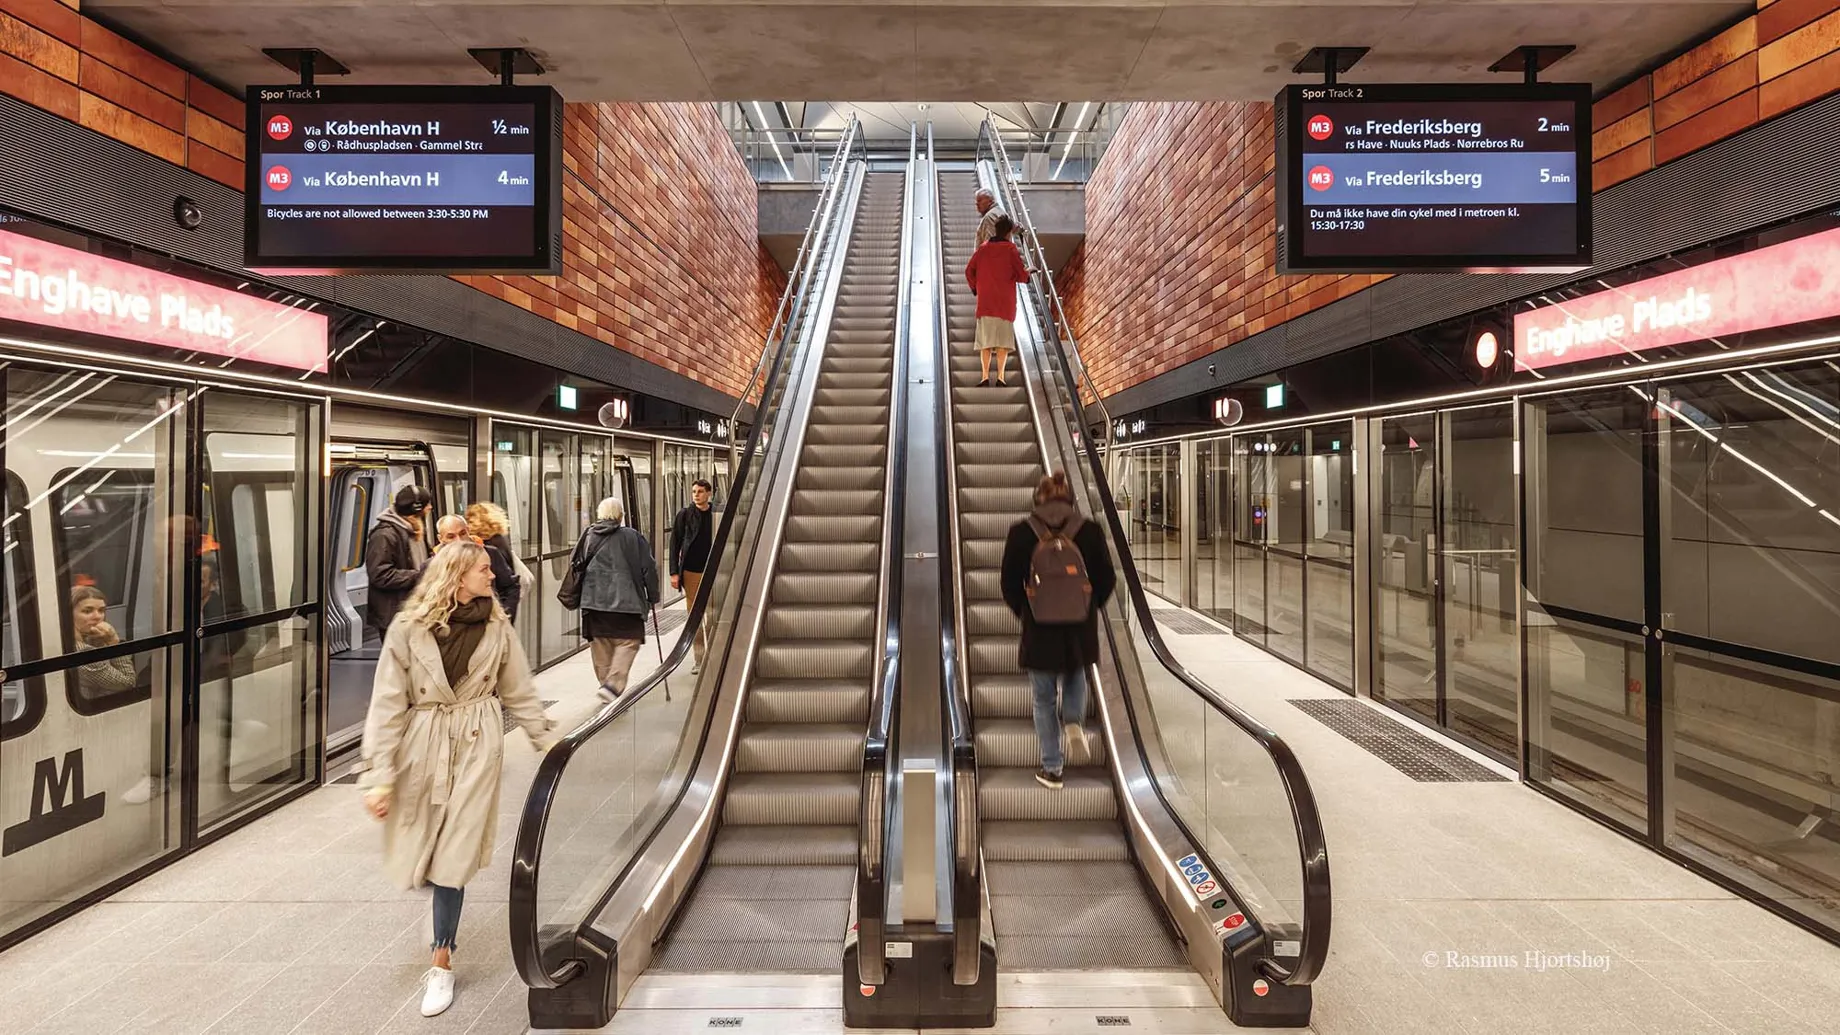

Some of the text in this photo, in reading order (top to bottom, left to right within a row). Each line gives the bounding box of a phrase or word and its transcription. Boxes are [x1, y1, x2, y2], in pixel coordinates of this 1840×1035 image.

[260, 89, 321, 101] Spor Track 1
[1302, 88, 1363, 99] Spor Track 2
[270, 122, 289, 133] M3
[304, 120, 440, 136] Via København H
[510, 125, 530, 135] min
[1311, 122, 1330, 133] M3
[1345, 119, 1482, 137] Via Frederiksberg
[1537, 117, 1570, 132] 2 min
[336, 139, 413, 152] Rådhuspladsen
[419, 140, 463, 151] Gammel
[1345, 139, 1525, 150] rs Have Nuuks Plads Nørrebros Ru
[269, 172, 289, 184] M3
[303, 171, 440, 187] Via København H
[497, 170, 529, 185] 4 min
[1311, 172, 1331, 184] M3
[1345, 170, 1483, 188] Via Frederiksberg
[1539, 168, 1571, 183] 5 min
[267, 208, 489, 220] Bicycles are not allowed between 3:30-5:30 PM
[1310, 207, 1520, 220] Du må ikke have din cykel med i metroen kl.
[1310, 220, 1365, 231] 15:30-17:30
[0, 254, 236, 340] Enghave Plads
[1526, 287, 1712, 357] Enghave Plads
